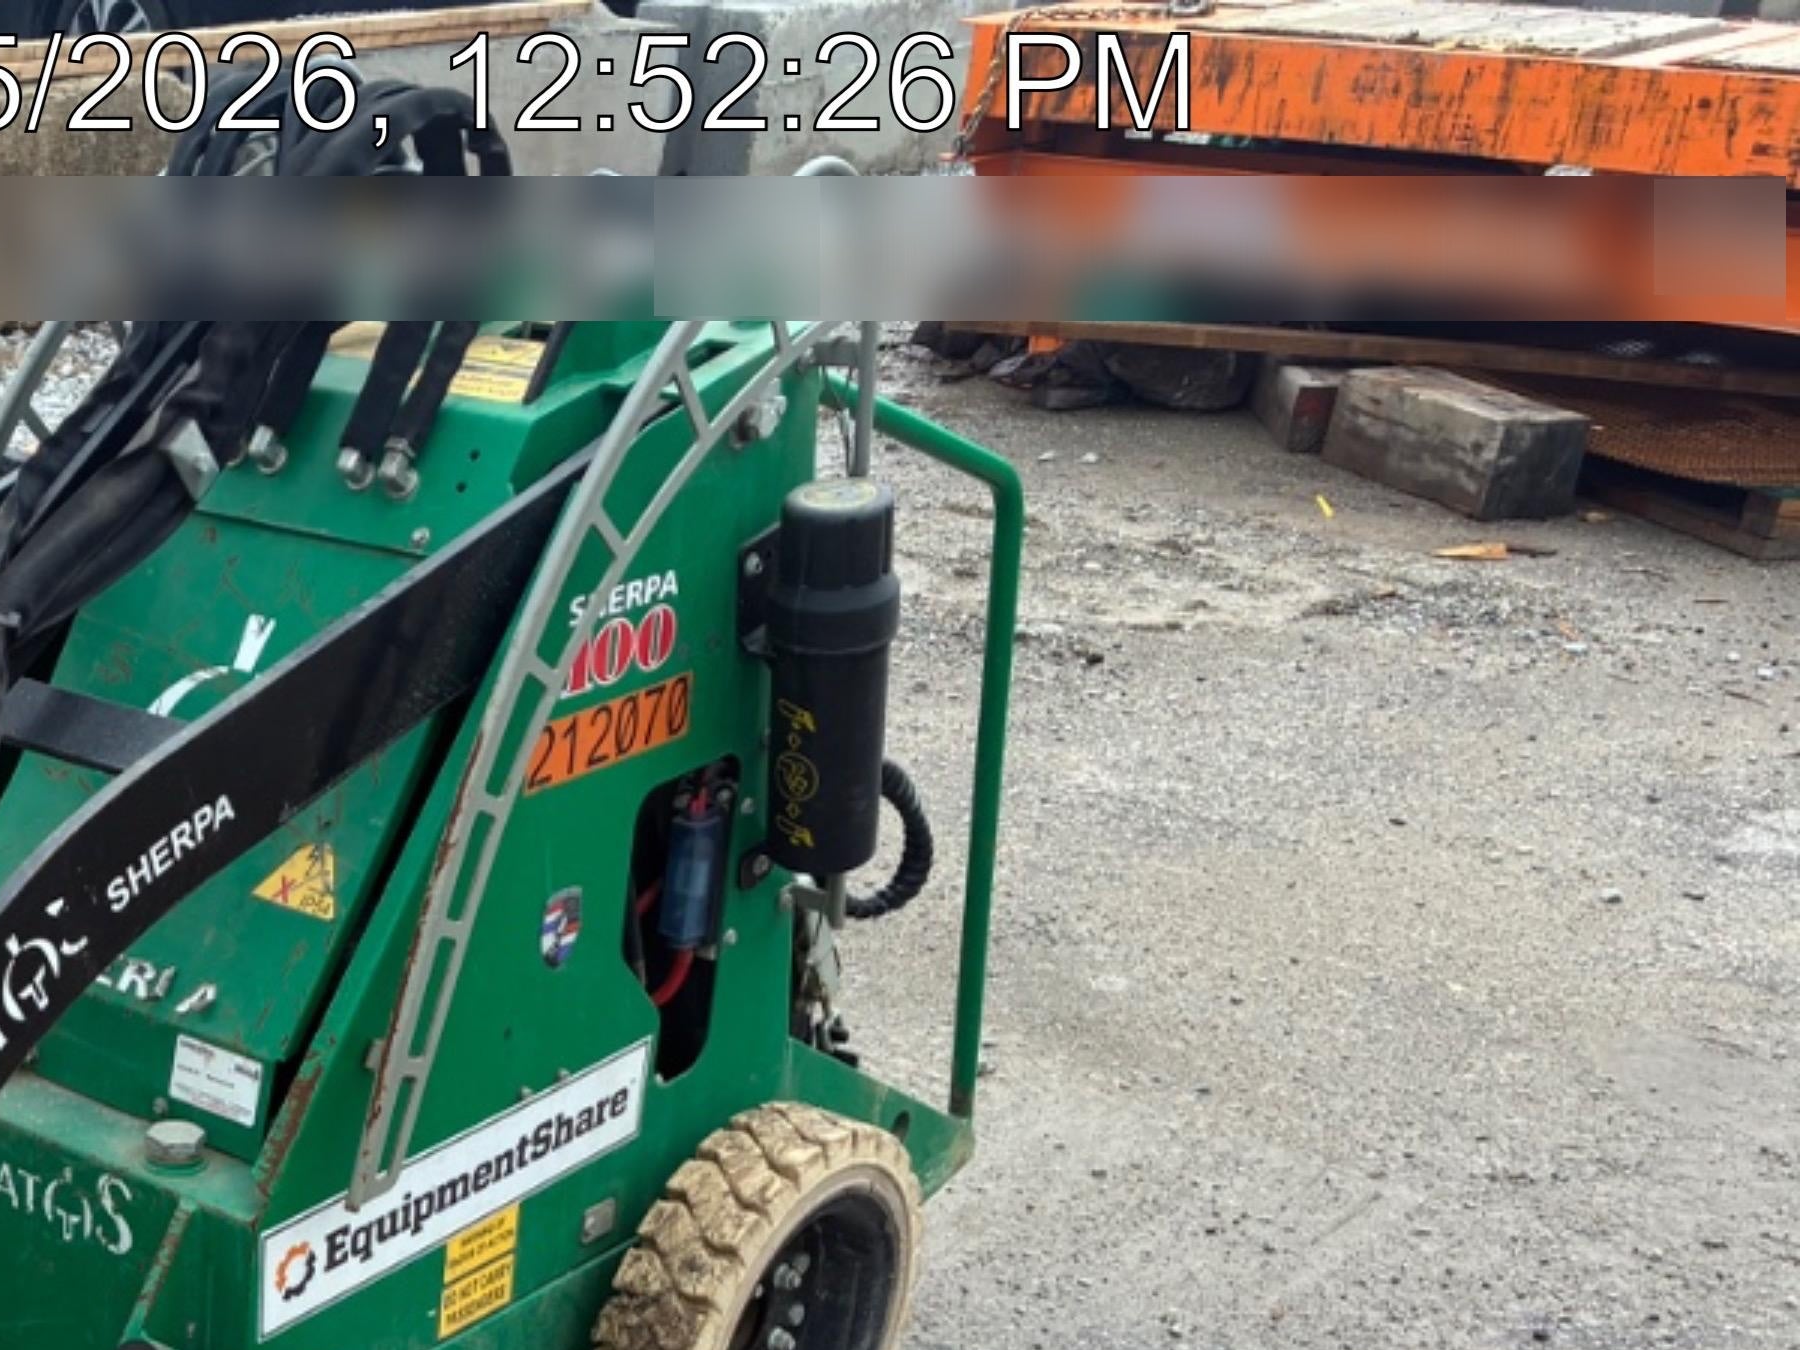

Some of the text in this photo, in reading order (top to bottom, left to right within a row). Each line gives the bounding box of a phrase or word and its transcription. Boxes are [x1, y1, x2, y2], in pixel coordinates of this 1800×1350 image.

[569, 570, 679, 628] SERPA
[527, 675, 690, 791] 212070
[106, 794, 235, 912] SHERPA
[323, 1086, 629, 1272] EquipmentShare
